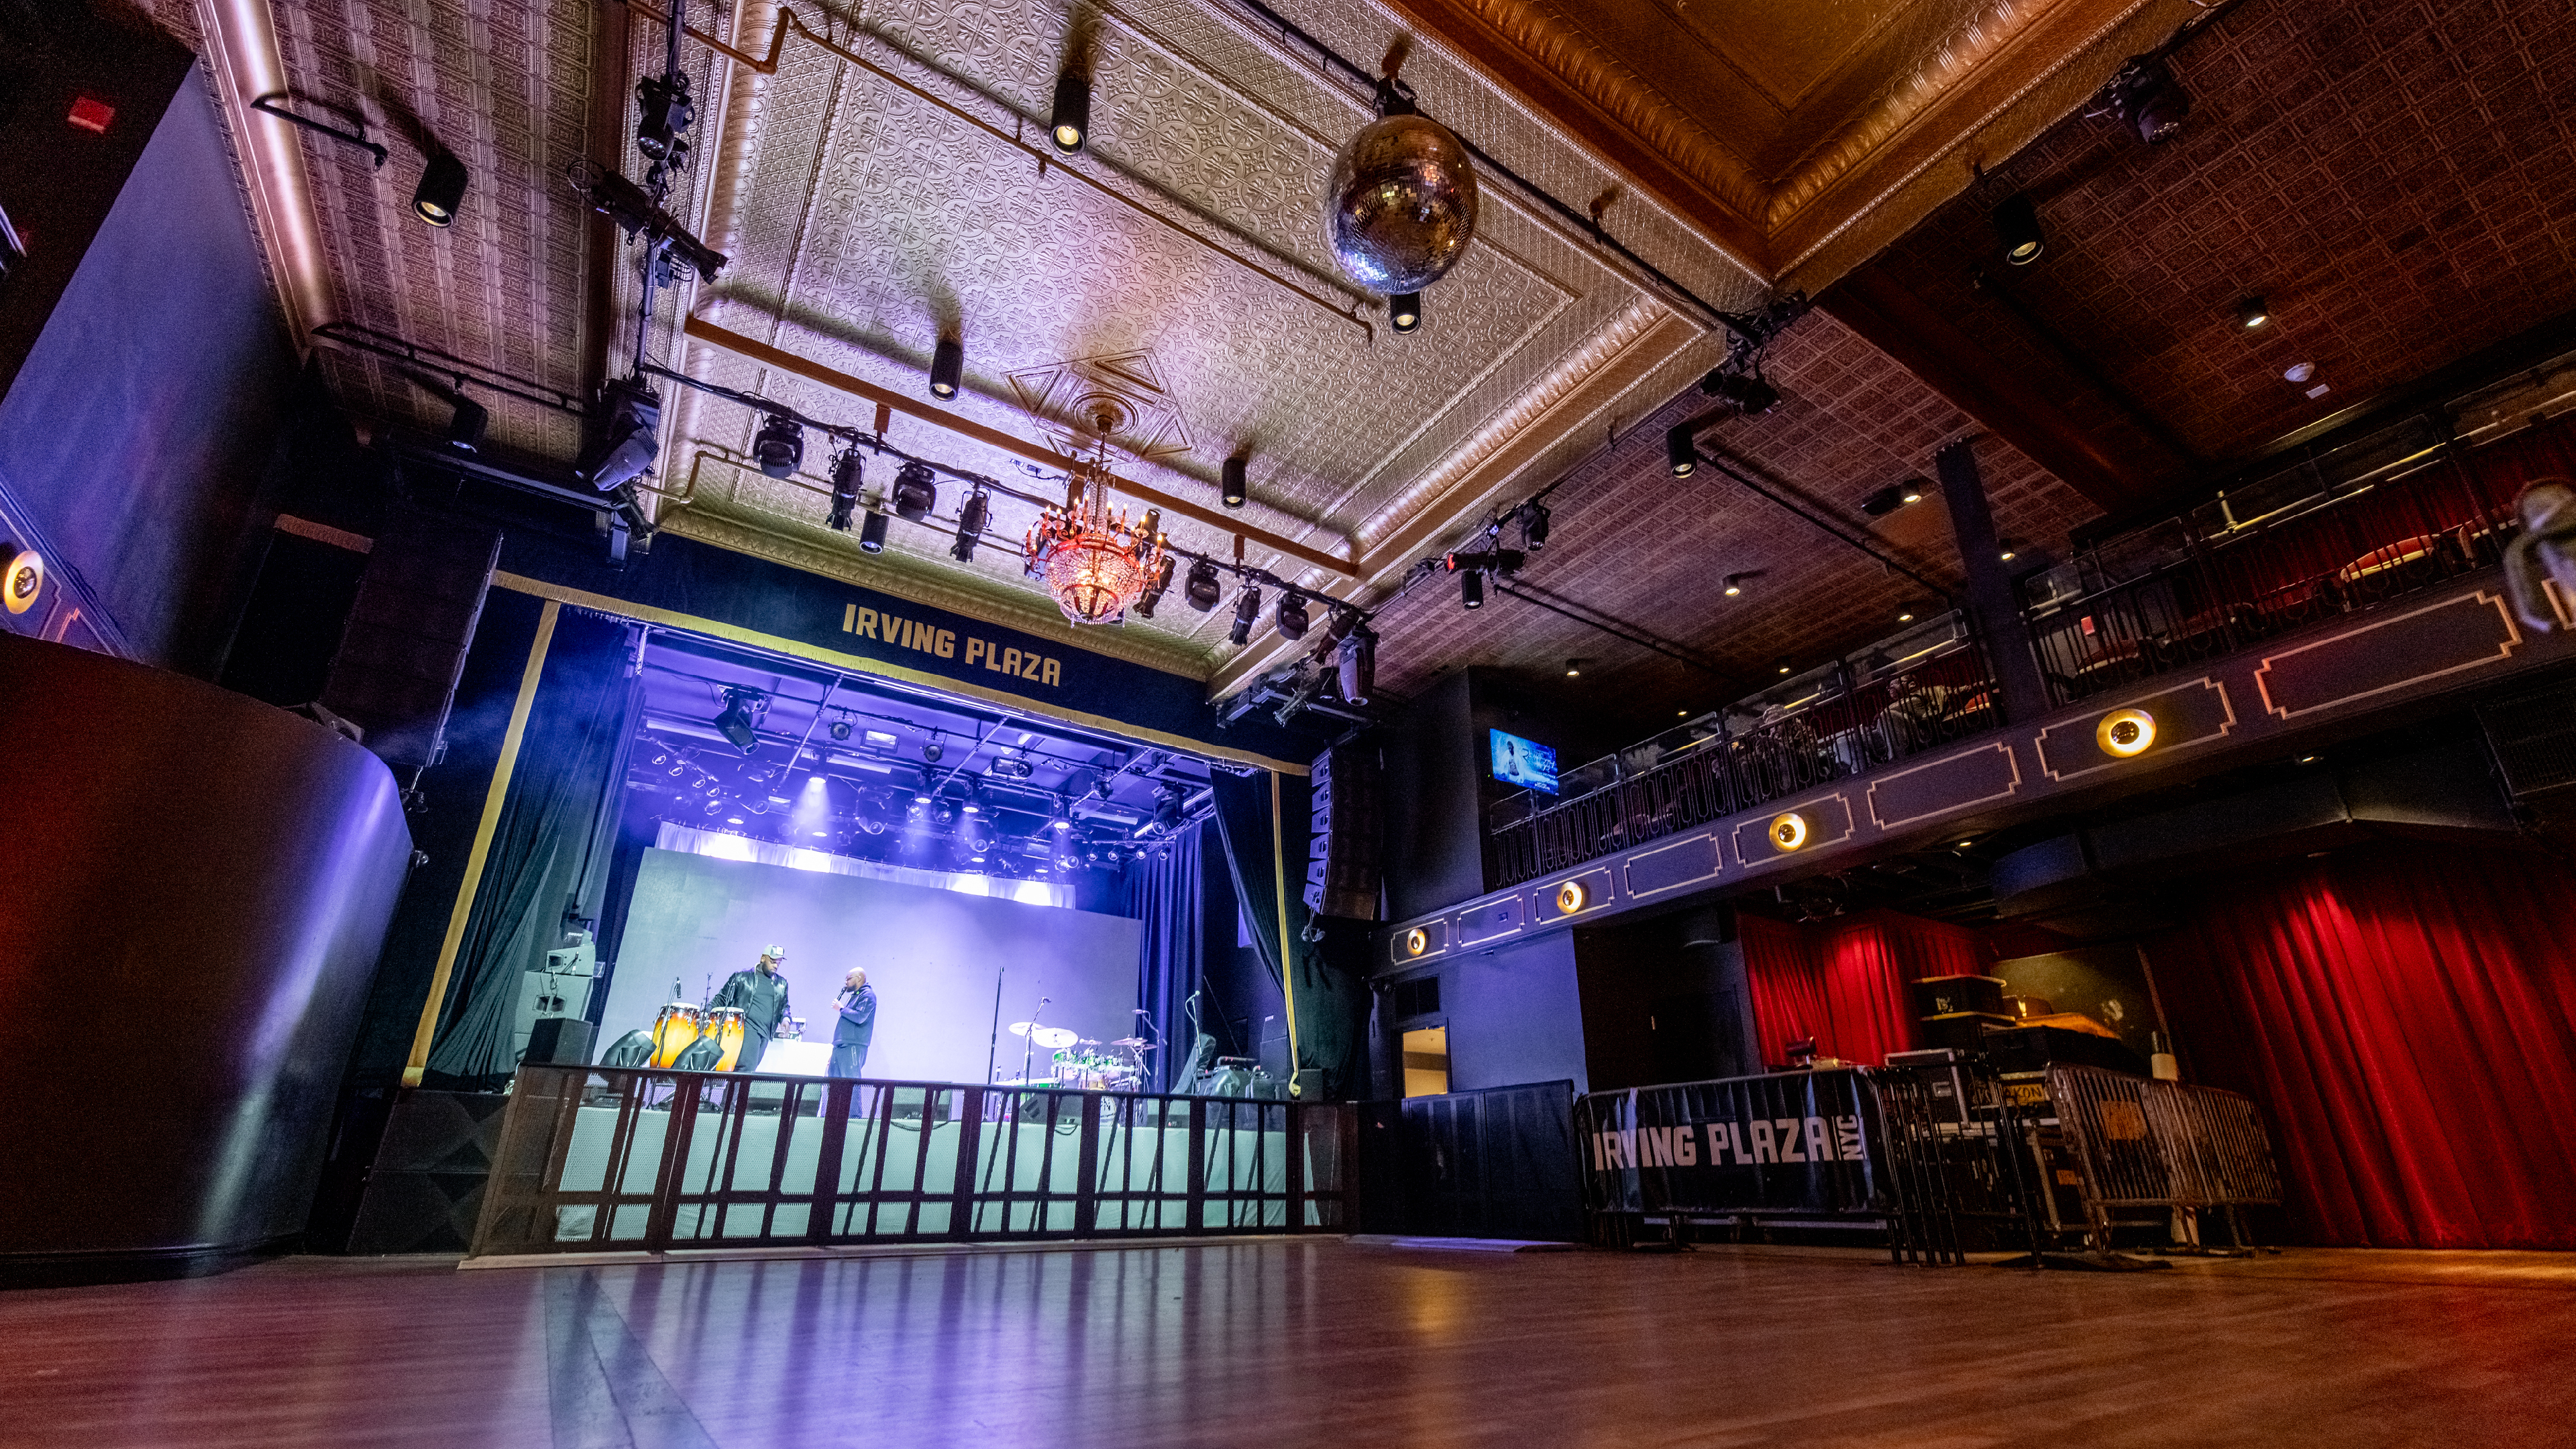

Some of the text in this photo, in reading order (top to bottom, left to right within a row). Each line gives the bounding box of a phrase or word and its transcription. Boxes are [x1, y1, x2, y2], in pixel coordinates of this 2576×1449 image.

[843, 604, 1061, 687] IRVING PLAZA
[1593, 1118, 1833, 1171] IRVING PLAZA
[1836, 1115, 1864, 1161] NYC
